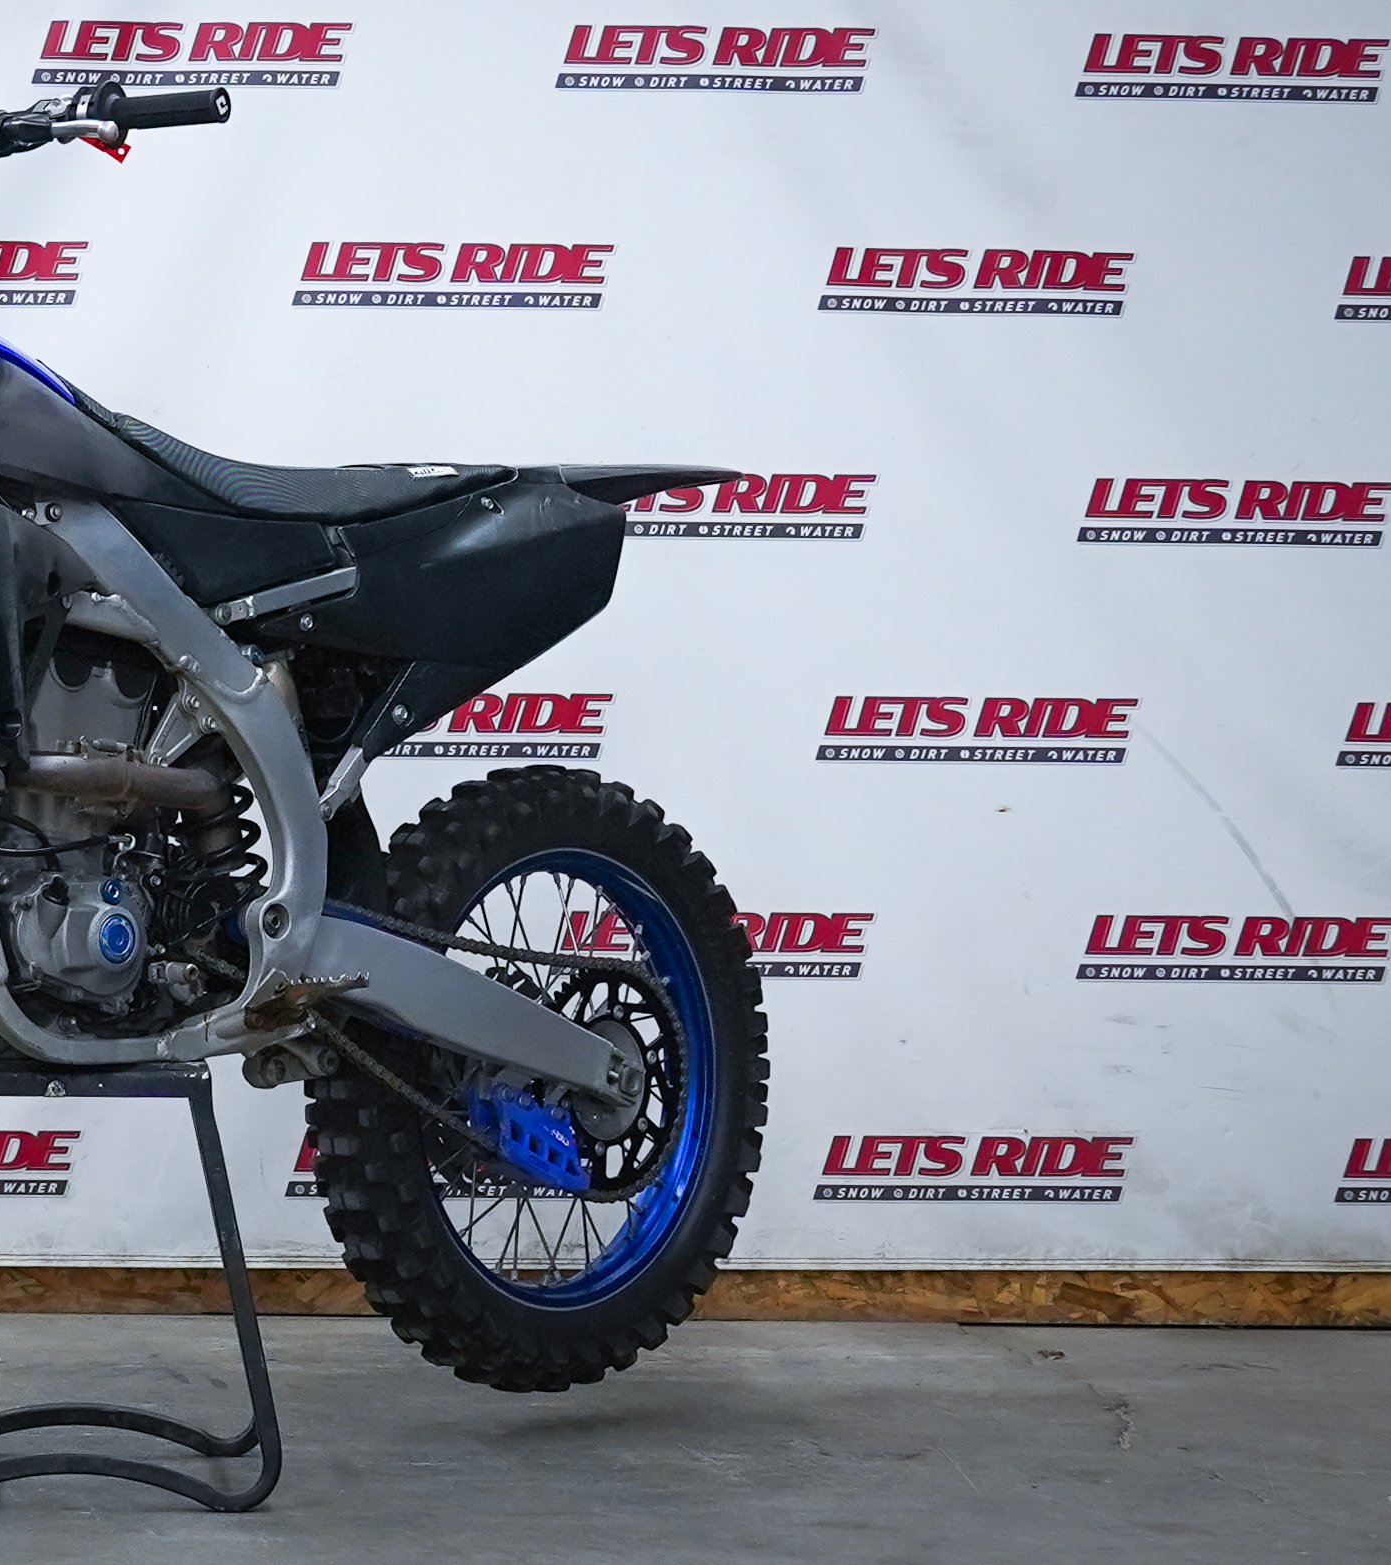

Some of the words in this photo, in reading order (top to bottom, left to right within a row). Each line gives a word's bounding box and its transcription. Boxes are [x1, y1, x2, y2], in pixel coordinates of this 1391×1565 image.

[38, 21, 185, 62] LETS
[187, 21, 355, 62] RIDE
[562, 24, 709, 65] LETS
[710, 27, 878, 68] RIDE
[1081, 34, 1228, 75] LETS
[1230, 37, 1390, 78] RIDE
[54, 71, 103, 84] SNOW
[124, 72, 166, 85] DIRT
[186, 72, 252, 85] STREET
[275, 73, 332, 86] WATER
[577, 75, 628, 88] SNOW
[648, 76, 690, 89] DIRT
[711, 77, 775, 90] STREET
[798, 78, 855, 91] WATER
[1097, 84, 1147, 97] SNOW
[1167, 85, 1209, 98] DIRT
[1228, 87, 1293, 100] STREET
[1315, 88, 1370, 101] WATER
[299, 241, 447, 282] LETS
[449, 243, 615, 284] RIDE
[823, 248, 970, 289] LETS
[972, 250, 1138, 291] RIDE
[11, 292, 68, 305] WATER
[314, 292, 365, 305] SNOW
[385, 293, 428, 306] DIRT
[448, 294, 514, 307] STREET
[537, 294, 594, 307] WATER
[840, 297, 889, 310] SNOW
[909, 299, 951, 312] DIRT
[971, 300, 1037, 313] STREET
[1061, 301, 1115, 314] WATER
[1356, 307, 1391, 319] SNO
[710, 473, 878, 514] RIDE
[1083, 478, 1231, 519] LETS
[1234, 480, 1391, 522] RIDE
[648, 523, 689, 536] DIRT
[710, 524, 776, 537] STREET
[799, 525, 855, 538] WATER
[1098, 529, 1149, 542] SNOW
[1170, 530, 1212, 543] DIRT
[1233, 531, 1297, 544] STREET
[1320, 532, 1374, 545] WATER
[447, 693, 614, 734] RIDE
[822, 696, 970, 737] LETS
[972, 697, 1141, 738] RIDE
[445, 744, 512, 757] STREET
[535, 745, 592, 758] WATER
[838, 747, 888, 760] SNOW
[908, 748, 951, 761] DIRT
[971, 749, 1037, 762] STREET
[1061, 749, 1118, 762] WATER
[1358, 754, 1391, 767] SNO
[1083, 915, 1231, 956] LETS
[1233, 916, 1391, 958] RIDE
[797, 964, 853, 977] WATER
[1098, 966, 1149, 979] SNOW
[1169, 967, 1211, 980] DIRT
[1231, 967, 1297, 980] STREET
[1321, 968, 1377, 981] WATER
[821, 1135, 968, 1176] LETS
[969, 1136, 1137, 1177] RIDE
[2, 1182, 59, 1195] WATER
[835, 1187, 886, 1200] SNOW
[907, 1187, 949, 1200] DIRT
[968, 1187, 1034, 1200] STREET
[1057, 1188, 1114, 1201] WATER
[1357, 1190, 1390, 1201] SNO
